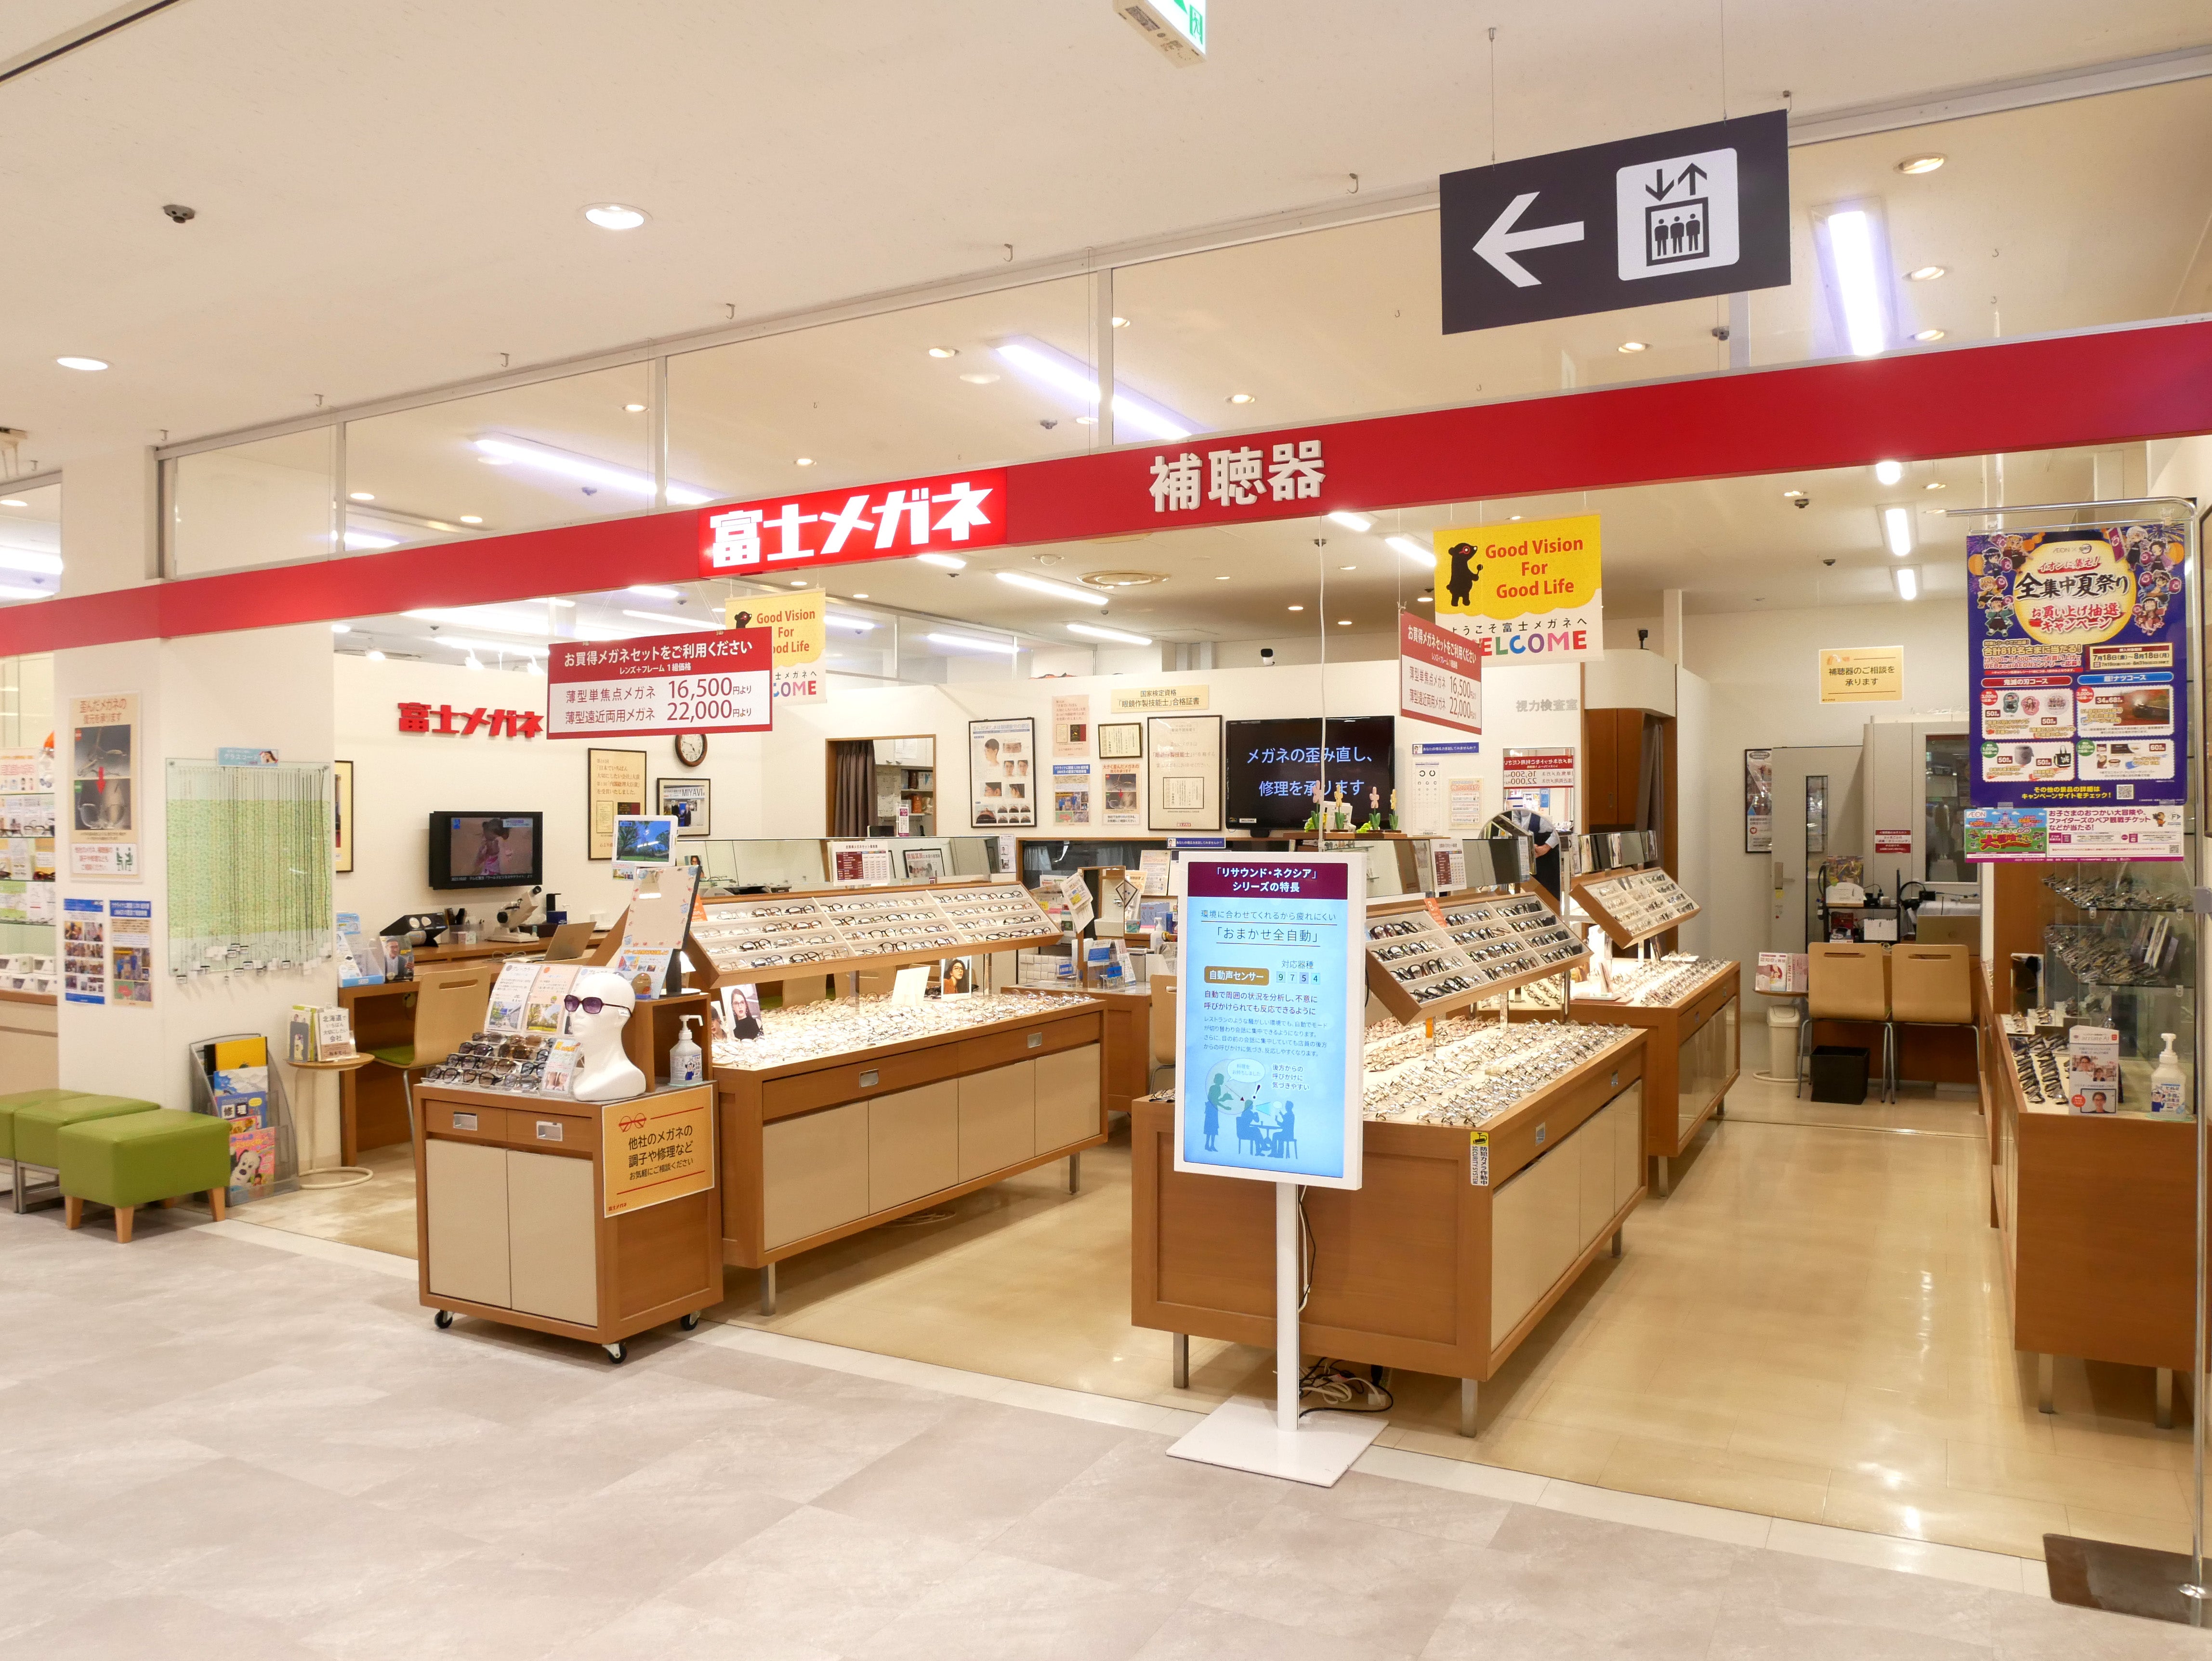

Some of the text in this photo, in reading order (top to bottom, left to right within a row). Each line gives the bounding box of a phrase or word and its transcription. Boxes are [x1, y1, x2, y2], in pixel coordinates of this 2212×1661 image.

[1149, 439, 1326, 513] 補聴器
[710, 481, 994, 569] 富士メガネ
[1486, 538, 1583, 559] Good Vision
[1522, 562, 1548, 576] For
[1497, 578, 1574, 598] Good Life
[2014, 572, 2129, 599] 全集中夏祭り
[757, 609, 815, 624] Good Vision
[2032, 603, 2120, 619] お買い上げ抽選
[2041, 618, 2112, 632] キャンペーン
[778, 627, 794, 638] For
[791, 640, 809, 652] Life
[1408, 625, 1476, 664] お買得メガネセットをご利用ください
[1481, 630, 1587, 657] ELCOME
[564, 640, 753, 667] お買得メガネセットをご利用ください
[1983, 645, 2082, 656] 合計818名さまに当たる!
[1829, 666, 1895, 676] 補聴器のご相談を
[1845, 677, 1879, 687] 承ります
[566, 677, 752, 703] 薄型単焦点メガネ 16,500円より
[1140, 689, 1177, 698] 国家検定資格
[1119, 697, 1199, 708] 「眼鏡作製技能士」合格証書
[1516, 699, 1578, 712] 視力検査室
[565, 699, 752, 725] 薄型遠近両用メガネ 22,000円より
[397, 702, 544, 738] 富士メガネ
[1246, 747, 1372, 764] メガネの歪み直し、
[597, 772, 640, 780] 大切にしたい会社」大賞
[2049, 816, 2151, 824] ファイターズのペア観戦チケット
[1217, 867, 1317, 879] 「リサウンド・ネクシア」
[1233, 882, 1300, 893] シリーズの特長
[1201, 910, 1336, 921] 環境に合わせてくれるから疲れにくい
[1218, 926, 1318, 943] 「おまかせ全自動」
[1281, 960, 1314, 970] 対応器種
[1209, 970, 1264, 982] 自動声センサー
[1204, 990, 1318, 1003] 自動で周囲の状況を分析し、不意に
[1204, 1002, 1316, 1015] 呼びかけられても反応できるように
[1204, 1016, 1328, 1028] レストランのような騒がしい環境でも、自動でモード
[1204, 1026, 1317, 1038] が切り替わり会話に集中できるようになります。
[1204, 1035, 1327, 1048] さらに、目の前の会話に集中していても店員の後方
[1204, 1044, 1319, 1057] からの呼びかけに気づき、反応しやすくなります。
[1272, 1064, 1304, 1072] 後方からの
[1272, 1073, 1303, 1081] 呼びかけに
[1272, 1082, 1310, 1091] 気づきやすい
[628, 1125, 693, 1151] 他社のメガネの
[628, 1140, 694, 1168] 調子や修理など
[629, 1158, 694, 1181] お気軽にご相談ください
